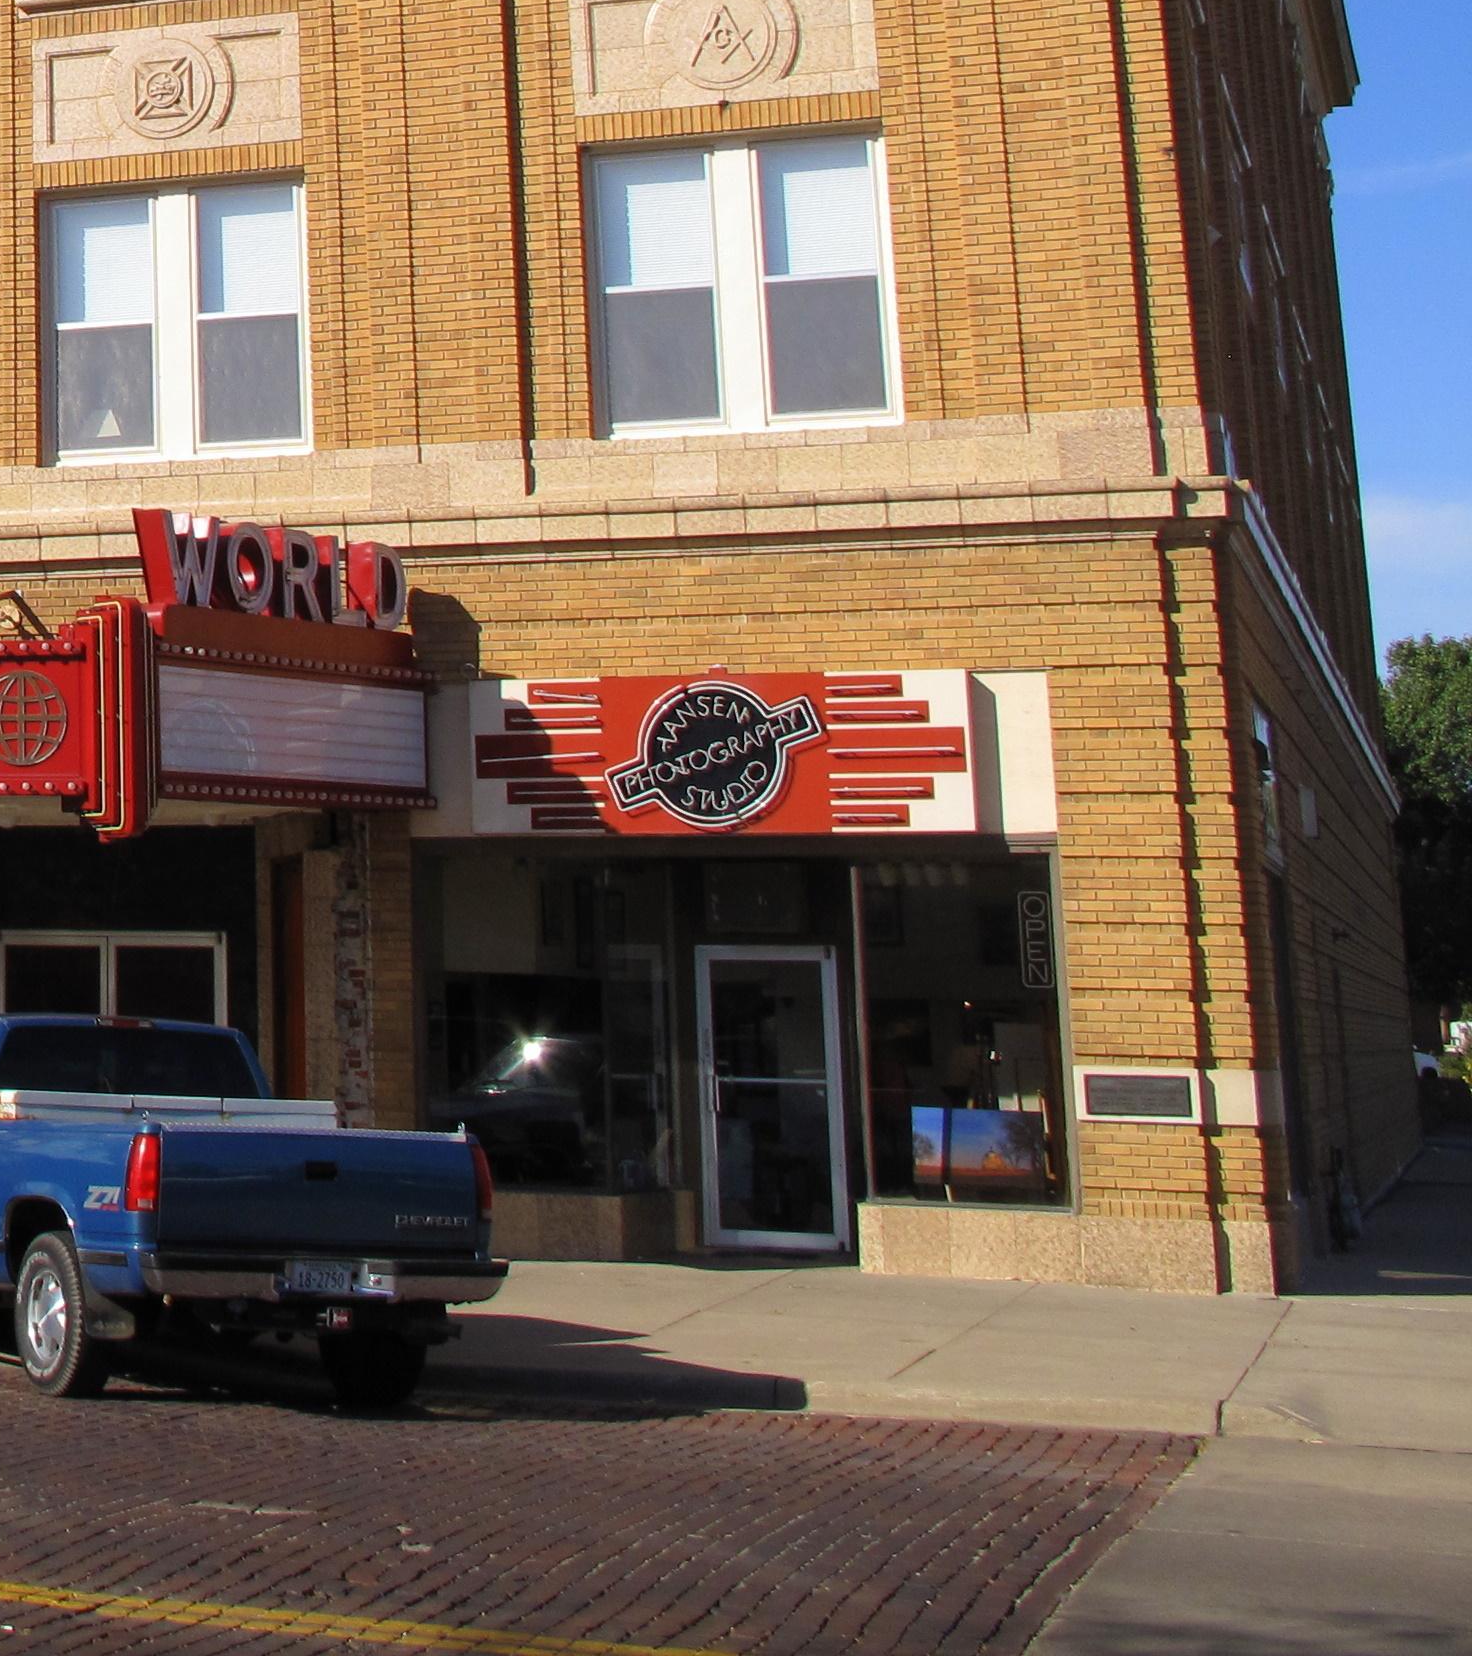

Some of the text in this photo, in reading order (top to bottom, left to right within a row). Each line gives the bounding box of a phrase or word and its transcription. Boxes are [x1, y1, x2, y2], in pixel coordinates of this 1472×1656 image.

[136, 508, 407, 632] WORLD
[624, 710, 798, 795] PHOTOGRAPHY
[680, 760, 768, 811] STUDIO
[1023, 896, 1049, 984] OPEN
[396, 1214, 469, 1228] CHEVROLET
[298, 1271, 345, 1289] 18-2750
